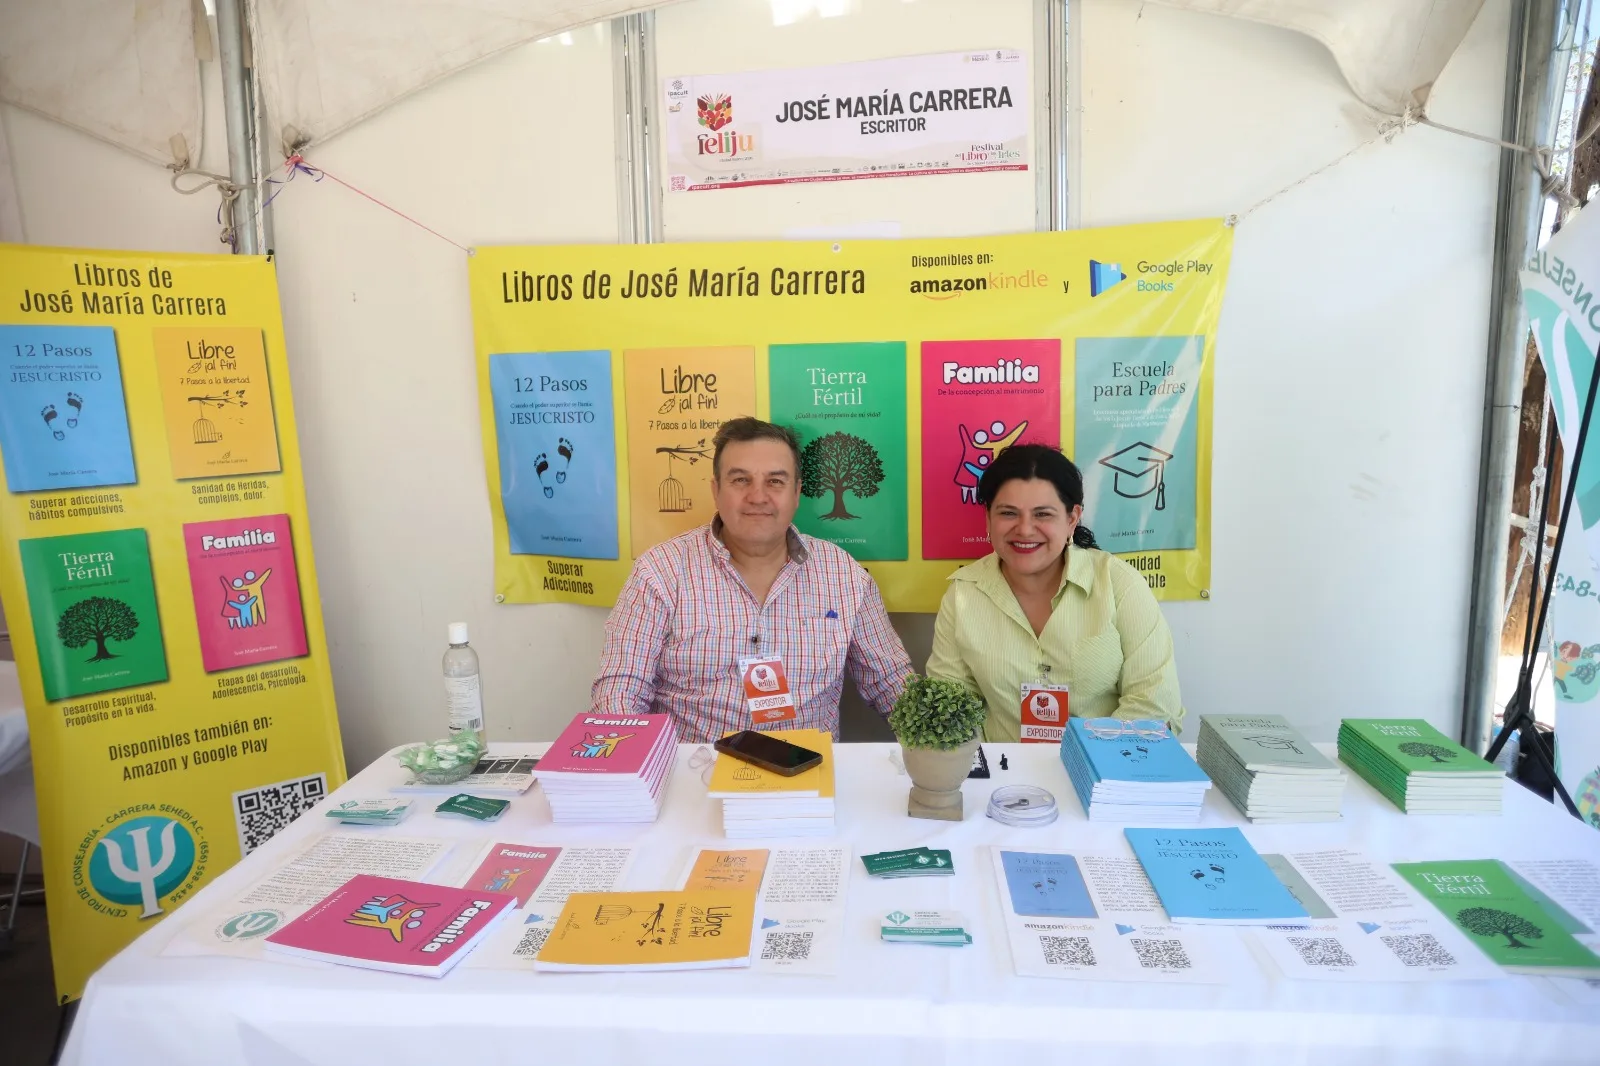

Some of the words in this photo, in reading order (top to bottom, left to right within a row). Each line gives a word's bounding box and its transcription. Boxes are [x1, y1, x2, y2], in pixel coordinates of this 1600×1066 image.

[775, 98, 831, 124] JOSÉ
[835, 89, 905, 119] MARÍA
[909, 85, 1013, 114] CARRERA
[859, 116, 926, 136] ESCRITOR
[697, 131, 754, 157] feliju
[971, 143, 1003, 152] Festival
[961, 151, 988, 161] Libro
[911, 253, 974, 268] Disponibles
[976, 252, 994, 266] en:
[1137, 260, 1184, 276] Google
[1186, 260, 1213, 276] Play
[73, 262, 141, 288] Libros
[148, 266, 173, 289] de
[502, 270, 573, 303] Libros
[582, 269, 611, 300] de
[621, 267, 678, 299] José
[688, 266, 760, 298] María
[770, 266, 865, 297] Carrera
[1062, 280, 1069, 294] y
[1137, 279, 1174, 292] Books
[20, 289, 74, 314] José
[81, 291, 145, 316] María
[152, 293, 227, 316] Carrera
[13, 344, 36, 357] 12
[42, 343, 93, 357] Pasos
[187, 339, 236, 360] Libre
[204, 359, 216, 373] ¡al
[220, 359, 237, 370] fin!
[942, 358, 1040, 385] Familia
[1112, 361, 1174, 378] Escuela
[10, 371, 102, 383] JESUCRISTO
[179, 377, 184, 385] 7
[186, 377, 206, 385] Pasos
[223, 375, 251, 384] libertad
[513, 377, 534, 393] 12
[540, 375, 588, 392] Pasos
[660, 365, 718, 394] Libre
[806, 368, 867, 385] Tierra
[813, 388, 863, 406] Fértil
[955, 388, 995, 396] concepción
[1093, 384, 1133, 402] para
[1139, 380, 1186, 396] Padres
[679, 395, 693, 414] ¡al
[697, 393, 718, 410] fin!
[509, 410, 595, 425] JESUCRISTO
[648, 420, 654, 431] 7
[656, 420, 679, 431] Pasos
[681, 422, 687, 430] a
[690, 419, 697, 430] la
[191, 484, 224, 495] Sanidad
[226, 483, 236, 492] de
[237, 480, 270, 490] Heridas,
[30, 497, 67, 511] Superar
[70, 493, 122, 507] adicciones,
[198, 493, 242, 505] complejos,
[243, 490, 266, 502] dolor.
[29, 507, 65, 521] hábitos
[67, 503, 126, 519] compulsivos.
[202, 528, 276, 551] Familia
[57, 551, 114, 566] Tierra
[66, 563, 113, 581] Fértil
[547, 560, 584, 578] Superar
[543, 576, 594, 595] Adicciones
[217, 675, 245, 688] Etapas
[246, 673, 258, 683] del
[260, 665, 301, 682] desarrollo,
[212, 684, 267, 700] Adolescencia,
[268, 674, 308, 690] Psicología.
[63, 700, 110, 717] Desarrollo
[112, 692, 156, 708] Espiritual,
[754, 696, 787, 709] EXPOSITOR
[65, 710, 109, 728] Propósito
[111, 709, 123, 718] en
[125, 706, 135, 716] la
[136, 703, 157, 714] vida.
[1036, 707, 1056, 717] feliju
[583, 717, 651, 727] Familia
[1370, 723, 1417, 731] Tierra
[109, 731, 191, 761] Disponibles
[194, 720, 250, 744] también
[253, 715, 273, 733] en:
[1026, 727, 1063, 739] EXPOSITOR
[1379, 729, 1422, 737] Fértil
[123, 757, 178, 782] Amazon
[181, 754, 189, 769] y
[193, 744, 238, 772] Google
[241, 737, 268, 761] Play
[105, 803, 156, 824] CARRERA
[158, 803, 193, 822] SEHEDI
[1153, 838, 1174, 847] 12
[1178, 838, 1226, 847] Pasos
[73, 828, 100, 887] CONSEJERÍA
[198, 840, 209, 864] (656)
[500, 849, 548, 860] Familia
[716, 855, 748, 864] Libre
[1157, 851, 1239, 859] JESUCRISTO
[1416, 872, 1487, 884] Tierra
[77, 887, 90, 901] DE
[1433, 883, 1492, 896] Fértil
[87, 898, 128, 918] CENTRO
[420, 900, 493, 953] Familia
[702, 906, 732, 937] Libre
